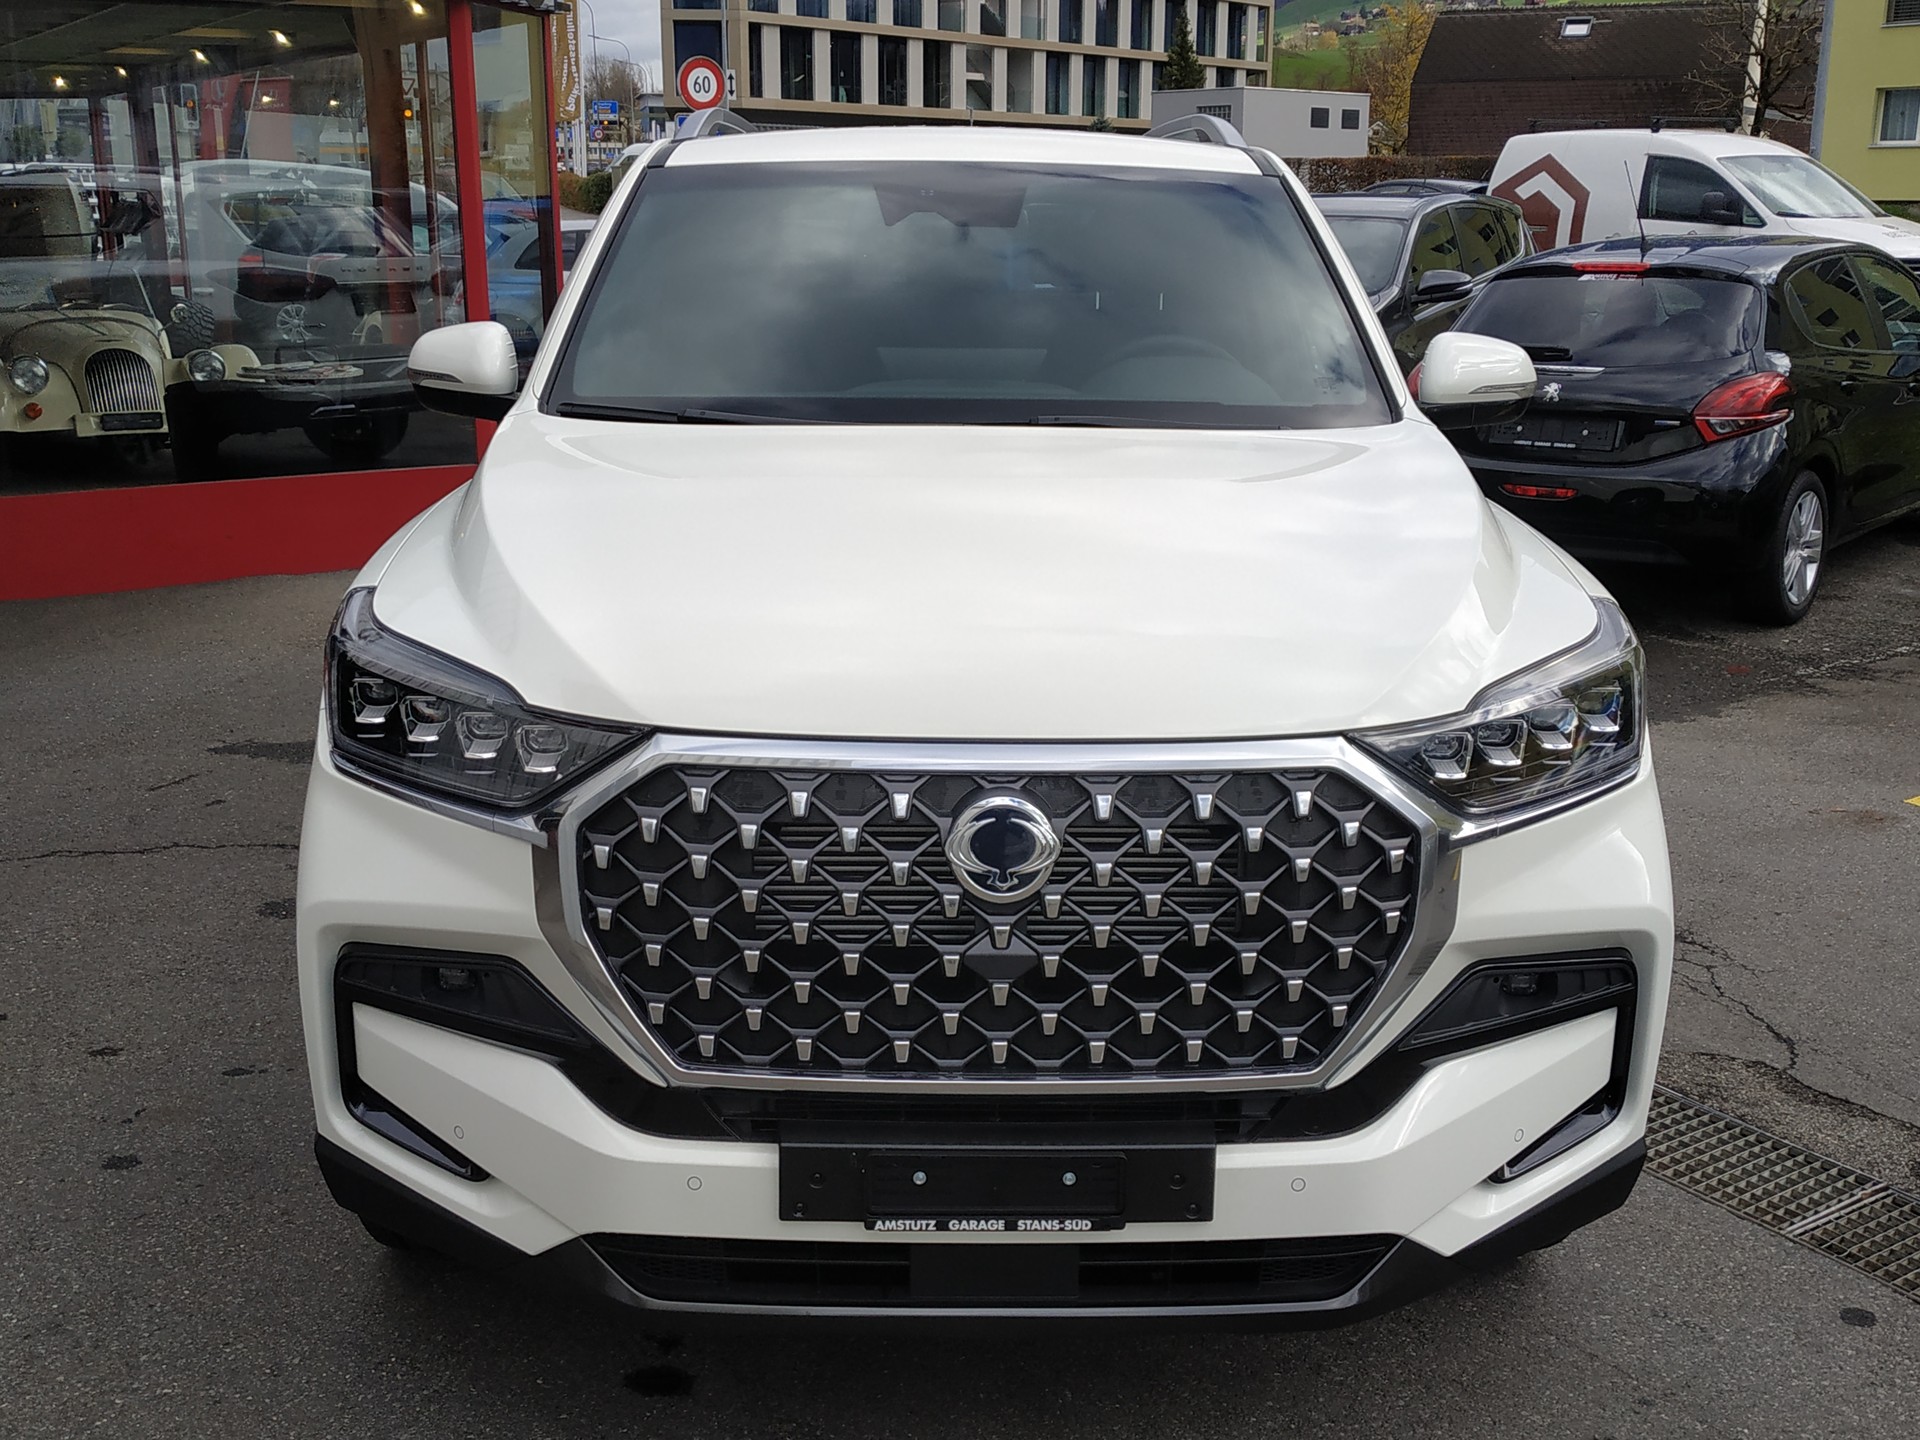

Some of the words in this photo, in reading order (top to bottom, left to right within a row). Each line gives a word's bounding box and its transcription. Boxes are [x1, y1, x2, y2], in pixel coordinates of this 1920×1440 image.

[693, 75, 711, 94] 60
[874, 1219, 937, 1231] AMSTUTZ
[948, 1219, 1005, 1231] GARAGE
[1017, 1218, 1092, 1231] STANS-SÜD
